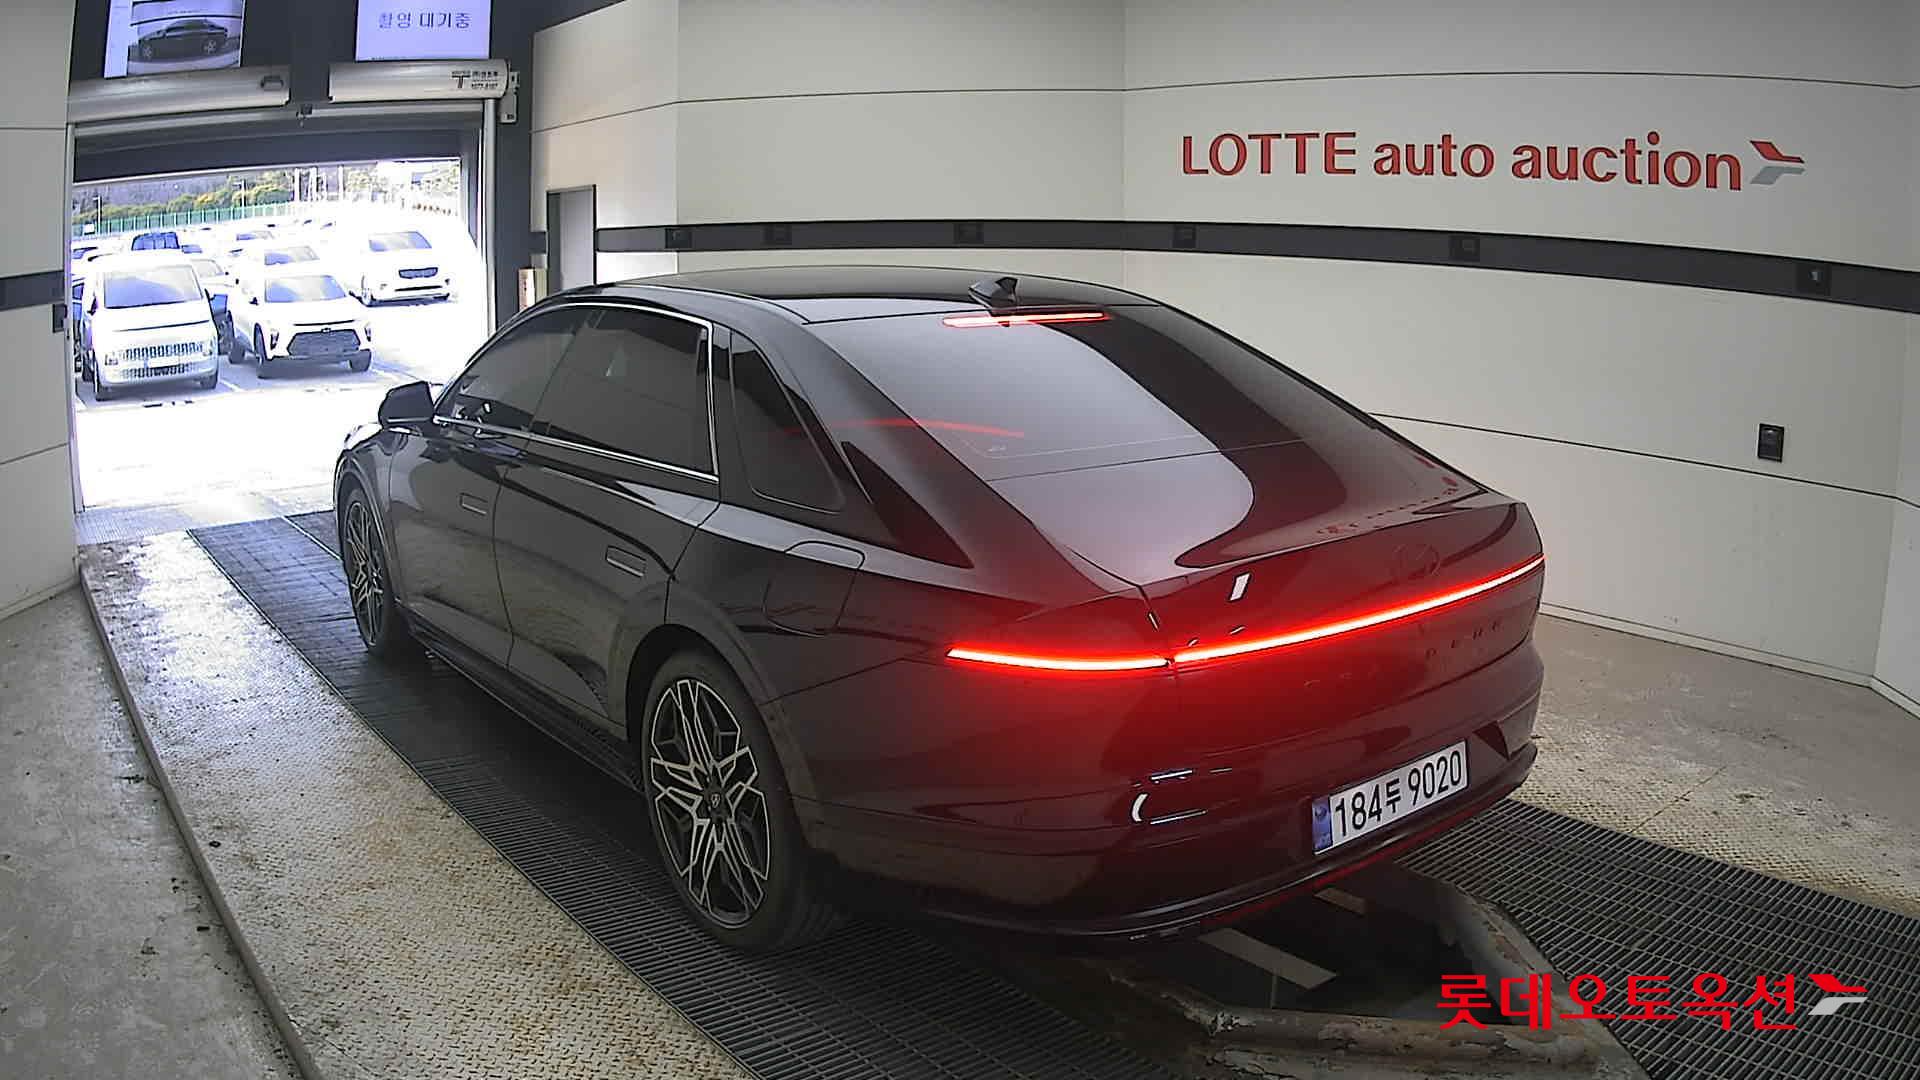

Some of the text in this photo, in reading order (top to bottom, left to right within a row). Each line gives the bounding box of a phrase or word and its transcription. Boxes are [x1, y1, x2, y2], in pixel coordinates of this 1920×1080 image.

[419, 12, 472, 29] 대기중
[1182, 131, 1743, 192] LOTTE auto auction
[1335, 750, 1462, 837] 184두 9020
